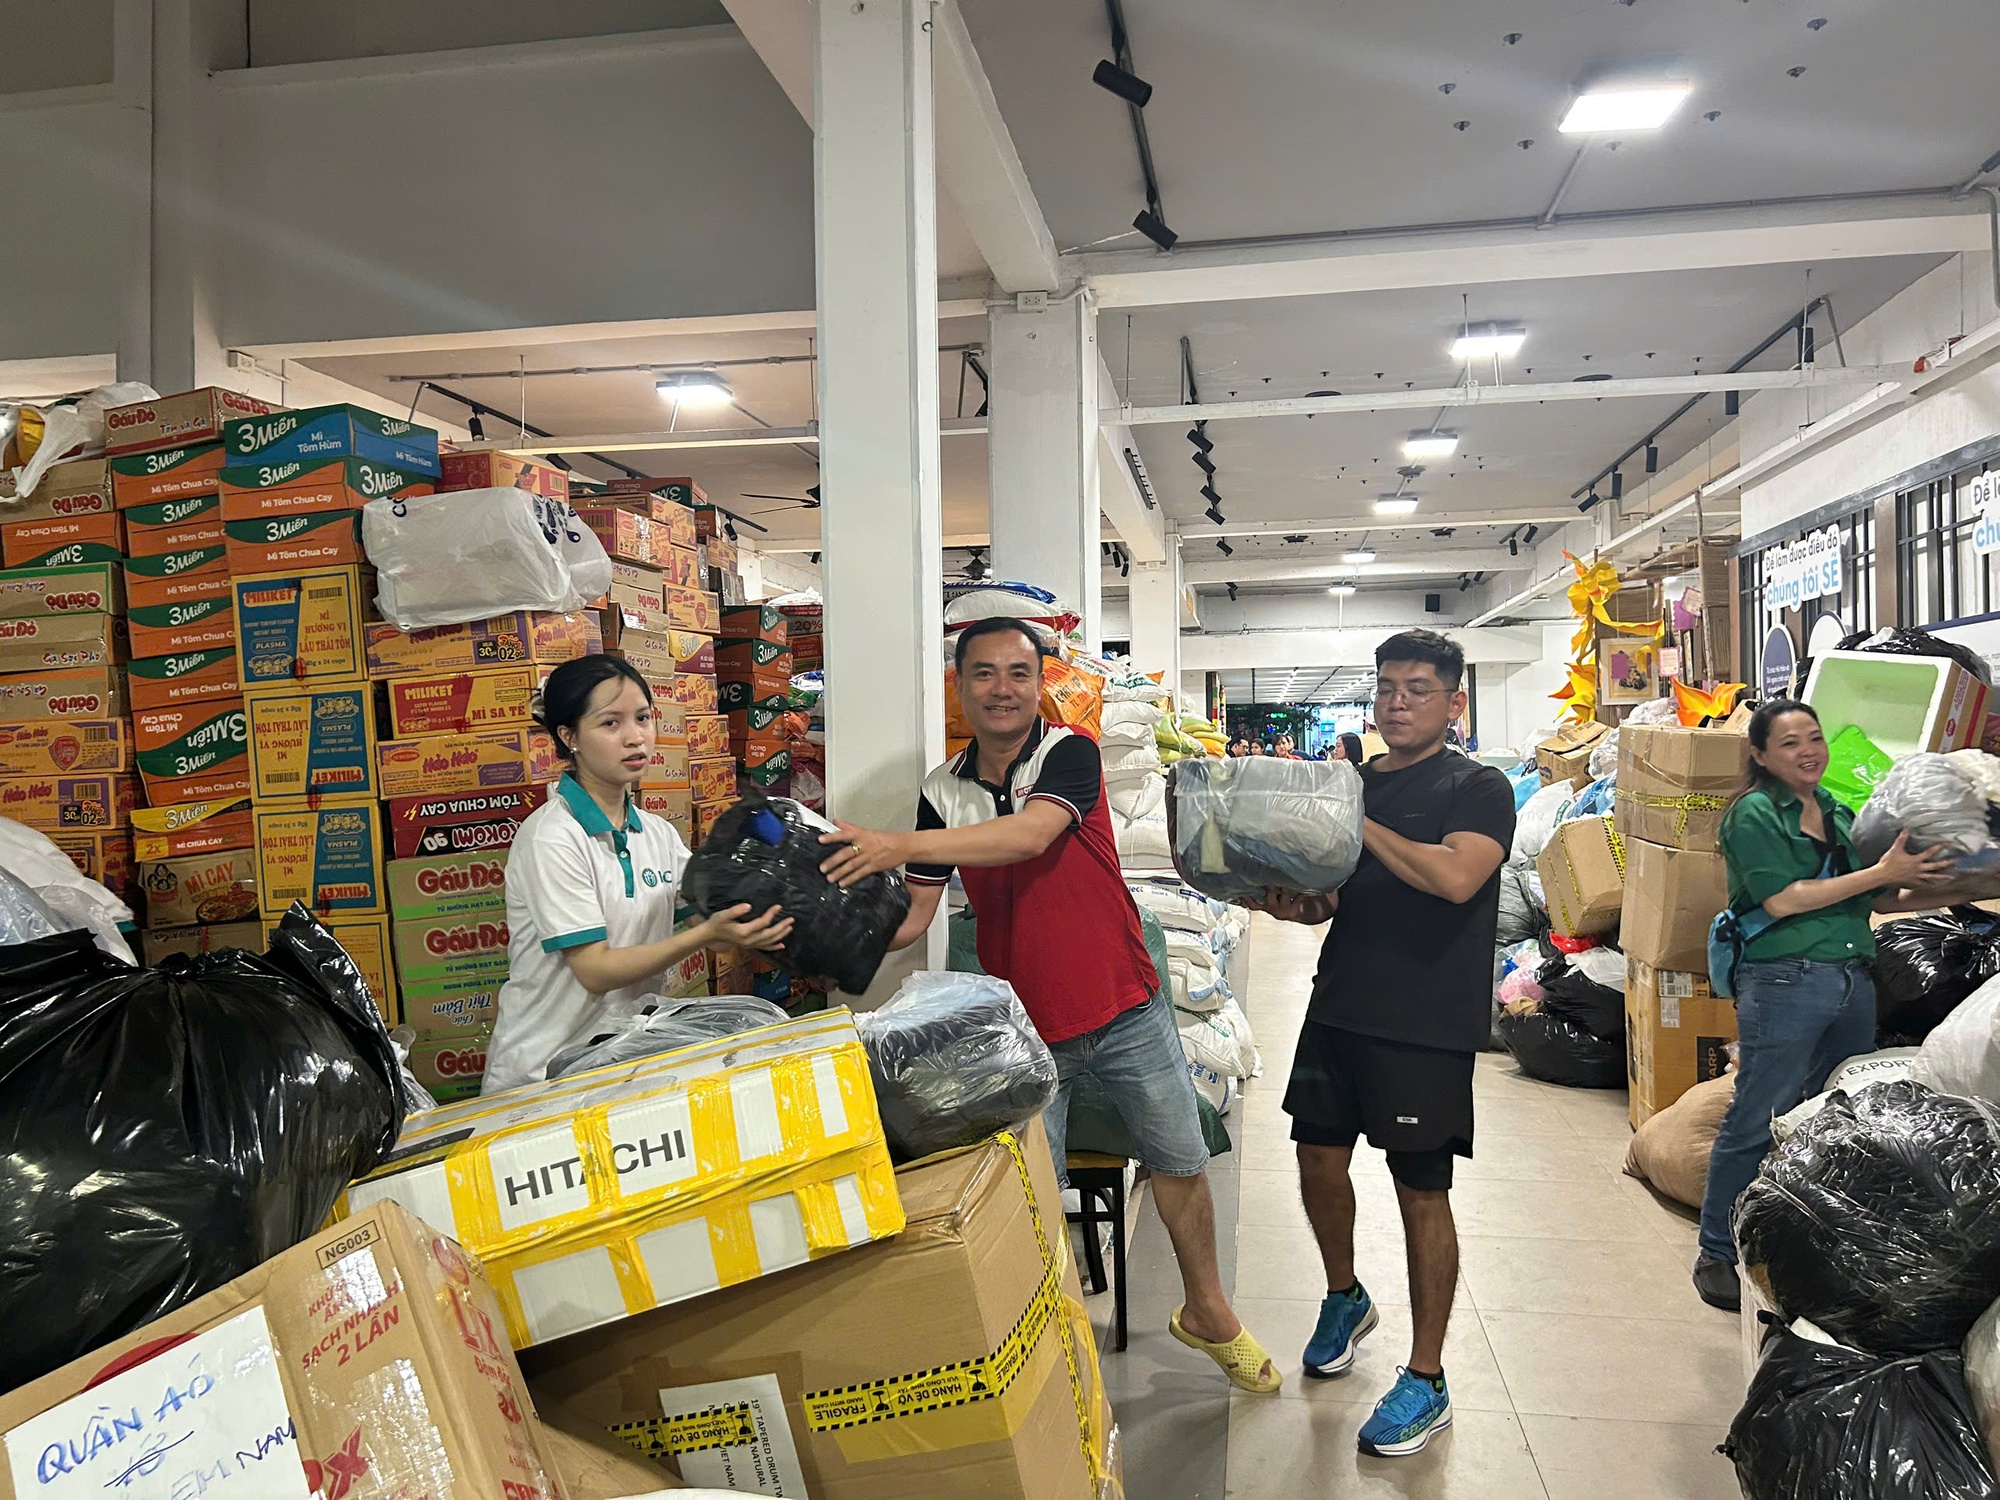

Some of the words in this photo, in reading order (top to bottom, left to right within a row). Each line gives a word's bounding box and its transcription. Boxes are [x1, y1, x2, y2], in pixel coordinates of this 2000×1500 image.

[311, 432, 323, 441] Mì
[297, 443, 318, 453] Tôm
[319, 440, 341, 451] Hùm
[152, 486, 162, 494] Mì
[163, 483, 180, 492] Tôm
[181, 480, 202, 490] Chua
[204, 479, 218, 487] Cay
[1974, 478, 1990, 505] Để
[262, 500, 272, 508] Mì
[274, 497, 291, 506] Tôm
[293, 496, 315, 504] Chua
[317, 494, 333, 504] Cay
[16, 529, 30, 537] Cay
[31, 527, 50, 536] Chua
[52, 525, 69, 533] Tôm
[178, 534, 196, 542] Tôm
[198, 531, 219, 540] Chua
[267, 552, 277, 561] Mì
[279, 550, 297, 559] Tôm
[299, 548, 321, 557] Chua
[323, 547, 338, 556] Cay
[1766, 554, 1774, 571] Để
[1776, 550, 1788, 566] làm
[1789, 541, 1807, 564] được
[1809, 537, 1825, 557] điều
[1827, 533, 1838, 549] đó
[1767, 573, 1799, 606] chúng
[1803, 567, 1819, 593] tôi
[1822, 552, 1839, 589] SẼ
[178, 585, 196, 593] Tôm
[198, 582, 219, 590] Chua
[245, 590, 295, 604] MILIKET
[795, 620, 822, 630] 20%
[183, 636, 201, 644] Tôm
[203, 632, 225, 641] Chua
[256, 641, 286, 649] PLASMA
[498, 648, 514, 661] 02
[181, 687, 198, 696] Tôm
[200, 685, 221, 693] Chua
[222, 682, 237, 690] Cay
[405, 685, 453, 700] MILIKET
[160, 713, 182, 722] Chua
[472, 707, 486, 720] MÌ
[491, 709, 505, 718] SA
[509, 702, 525, 716] TẾ
[141, 715, 158, 724] Cay
[322, 724, 352, 732] PLASMA
[315, 769, 362, 783] MILIKET
[194, 786, 212, 795] Tôm
[236, 781, 250, 789] Cay
[450, 798, 487, 813] CHUA
[489, 794, 520, 810] TÔM
[420, 803, 446, 816] CAY
[187, 840, 207, 848] CHUA
[424, 832, 448, 851] 90
[185, 871, 204, 894] MÌ
[205, 861, 234, 886] CAY
[505, 1128, 687, 1207] HITACHI
[325, 1229, 371, 1261] NG003
[337, 1343, 350, 1367] 2
[355, 1305, 399, 1352] LẦN
[303, 1327, 341, 1369] SẠCH
[933, 1383, 962, 1397] HÀNG
[812, 1402, 828, 1410] CARE
[815, 1403, 867, 1421] FRAGILE
[756, 1416, 771, 1454] TAPERED
[766, 1456, 779, 1483] DRUM
[751, 1446, 766, 1487] NATURAL
[725, 1464, 735, 1487] NAM
